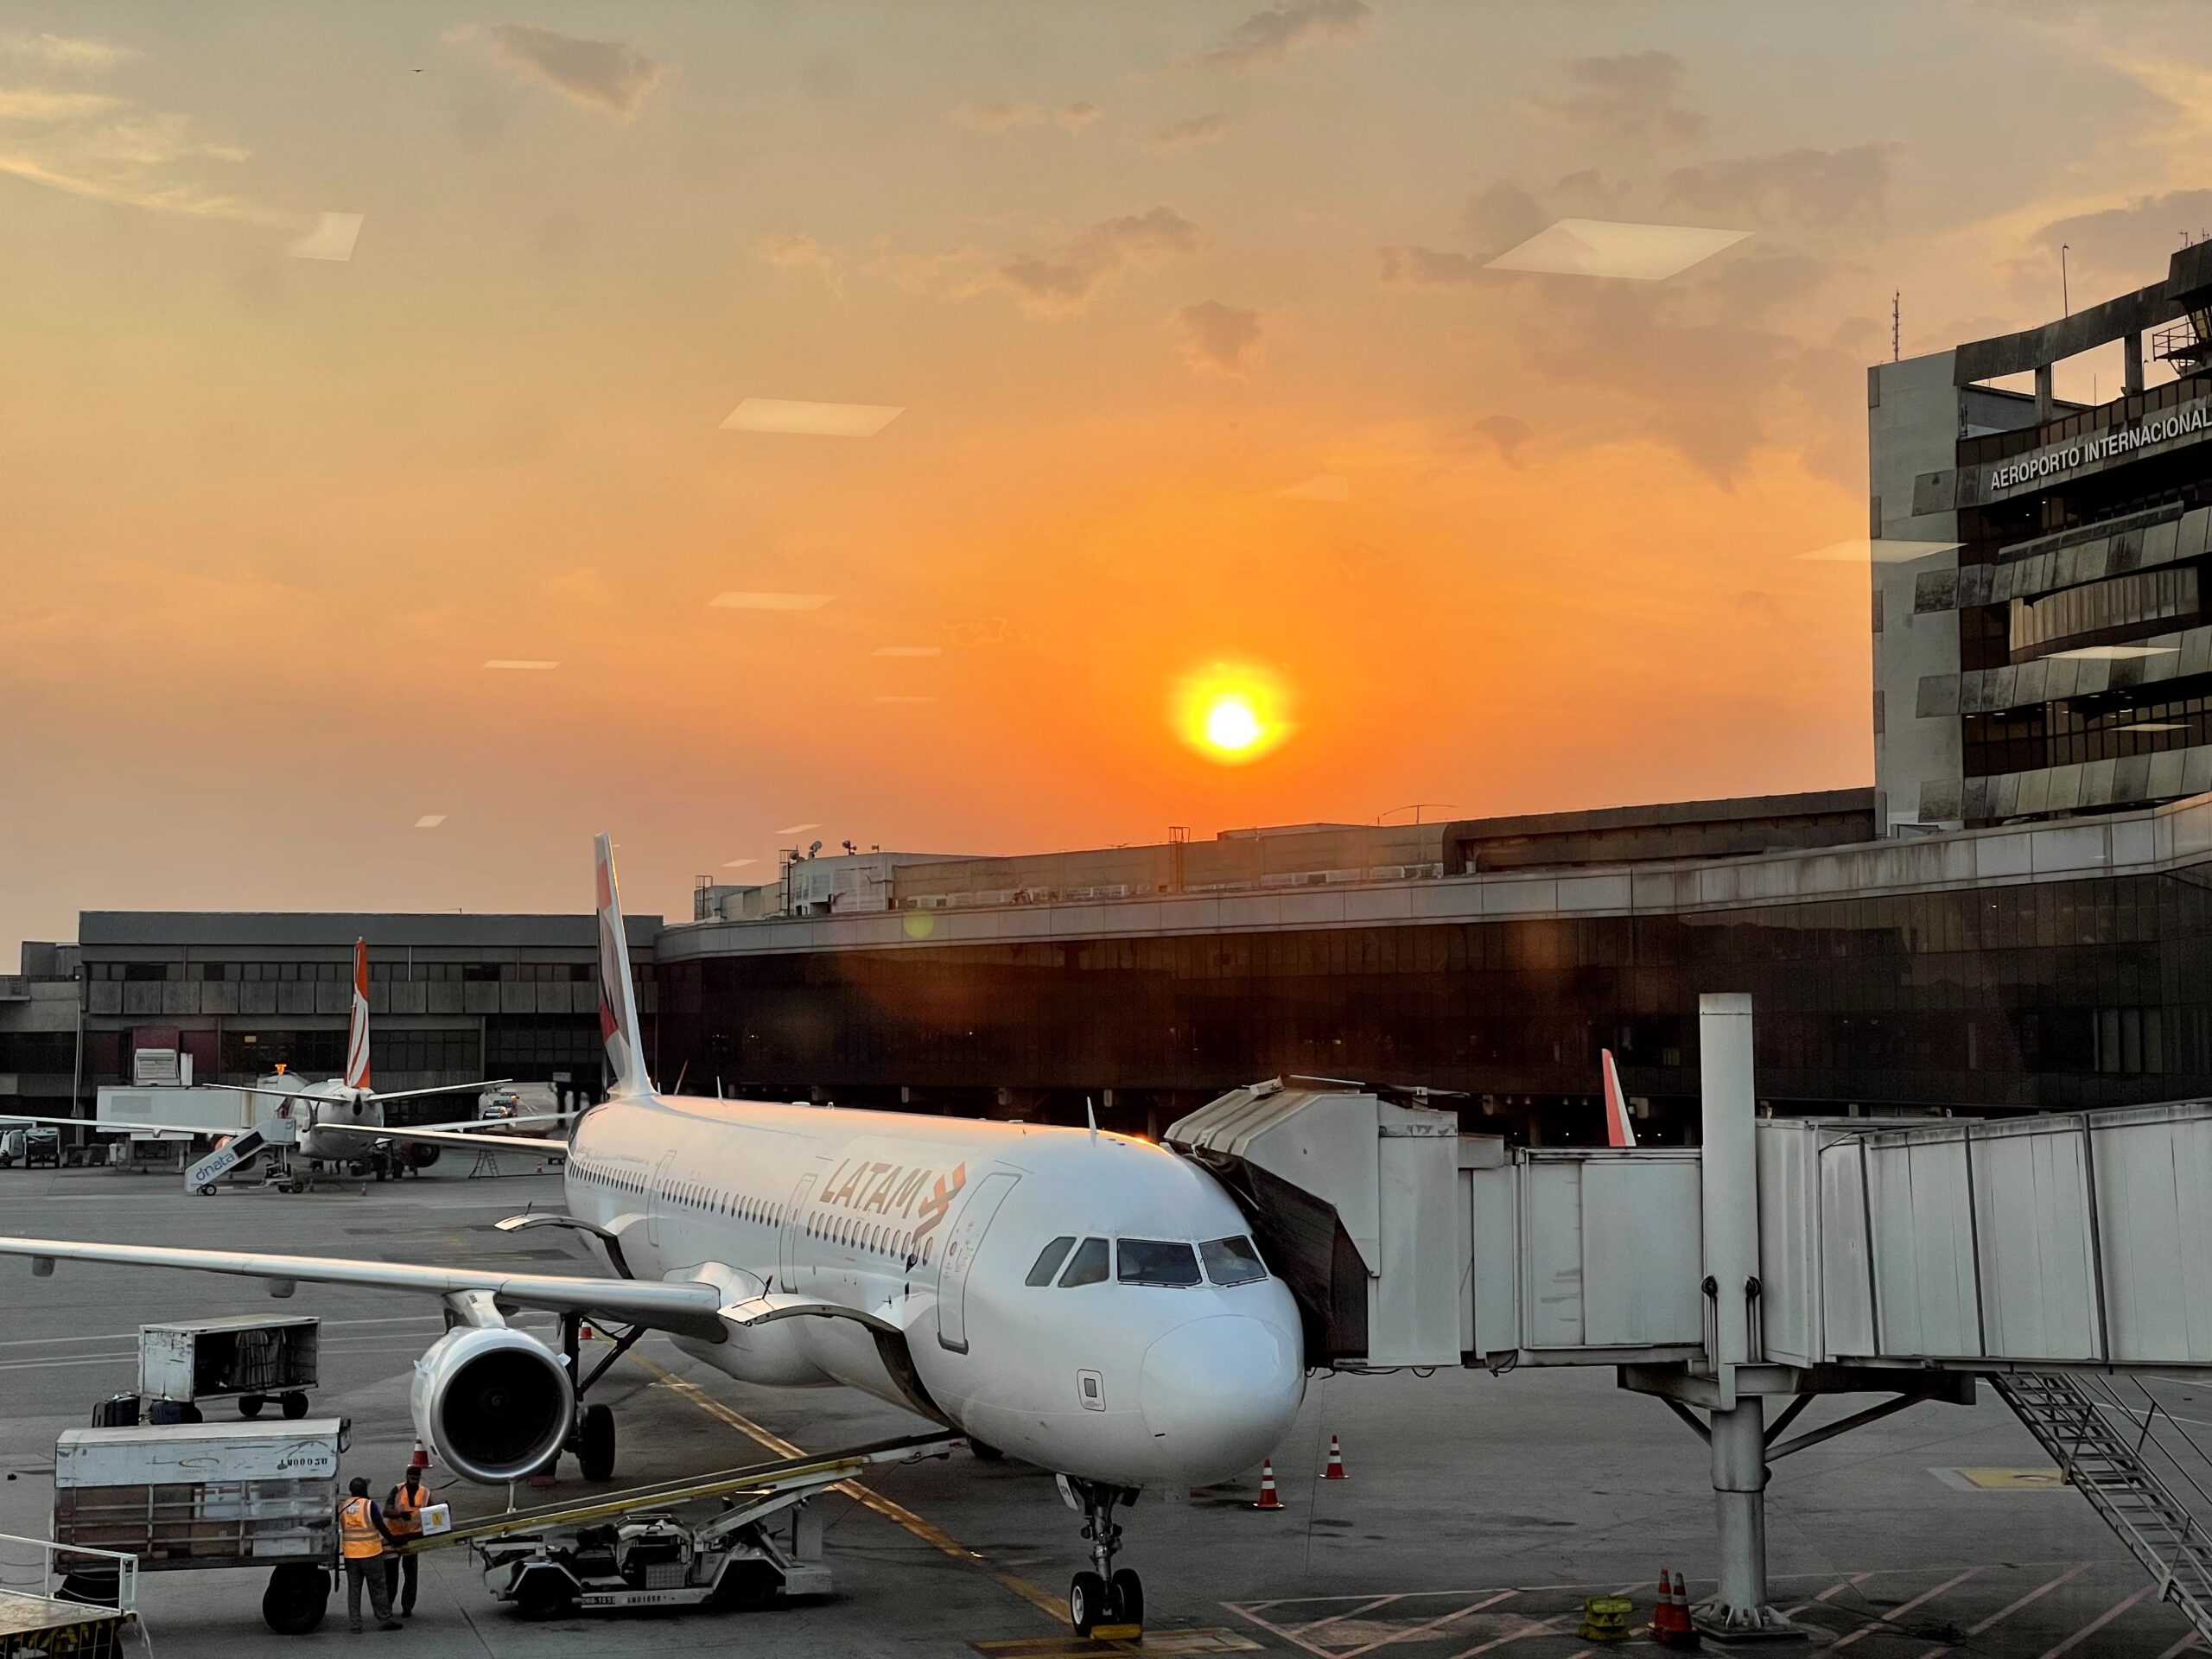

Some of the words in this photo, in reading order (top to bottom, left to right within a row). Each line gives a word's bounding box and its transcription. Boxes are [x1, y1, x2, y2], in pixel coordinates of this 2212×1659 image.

[1991, 448, 2080, 491] AEROPORTO
[2084, 407, 2212, 463] INTERNACIONAL
[195, 1152, 235, 1181] dnata
[819, 1158, 932, 1219] LATAM
